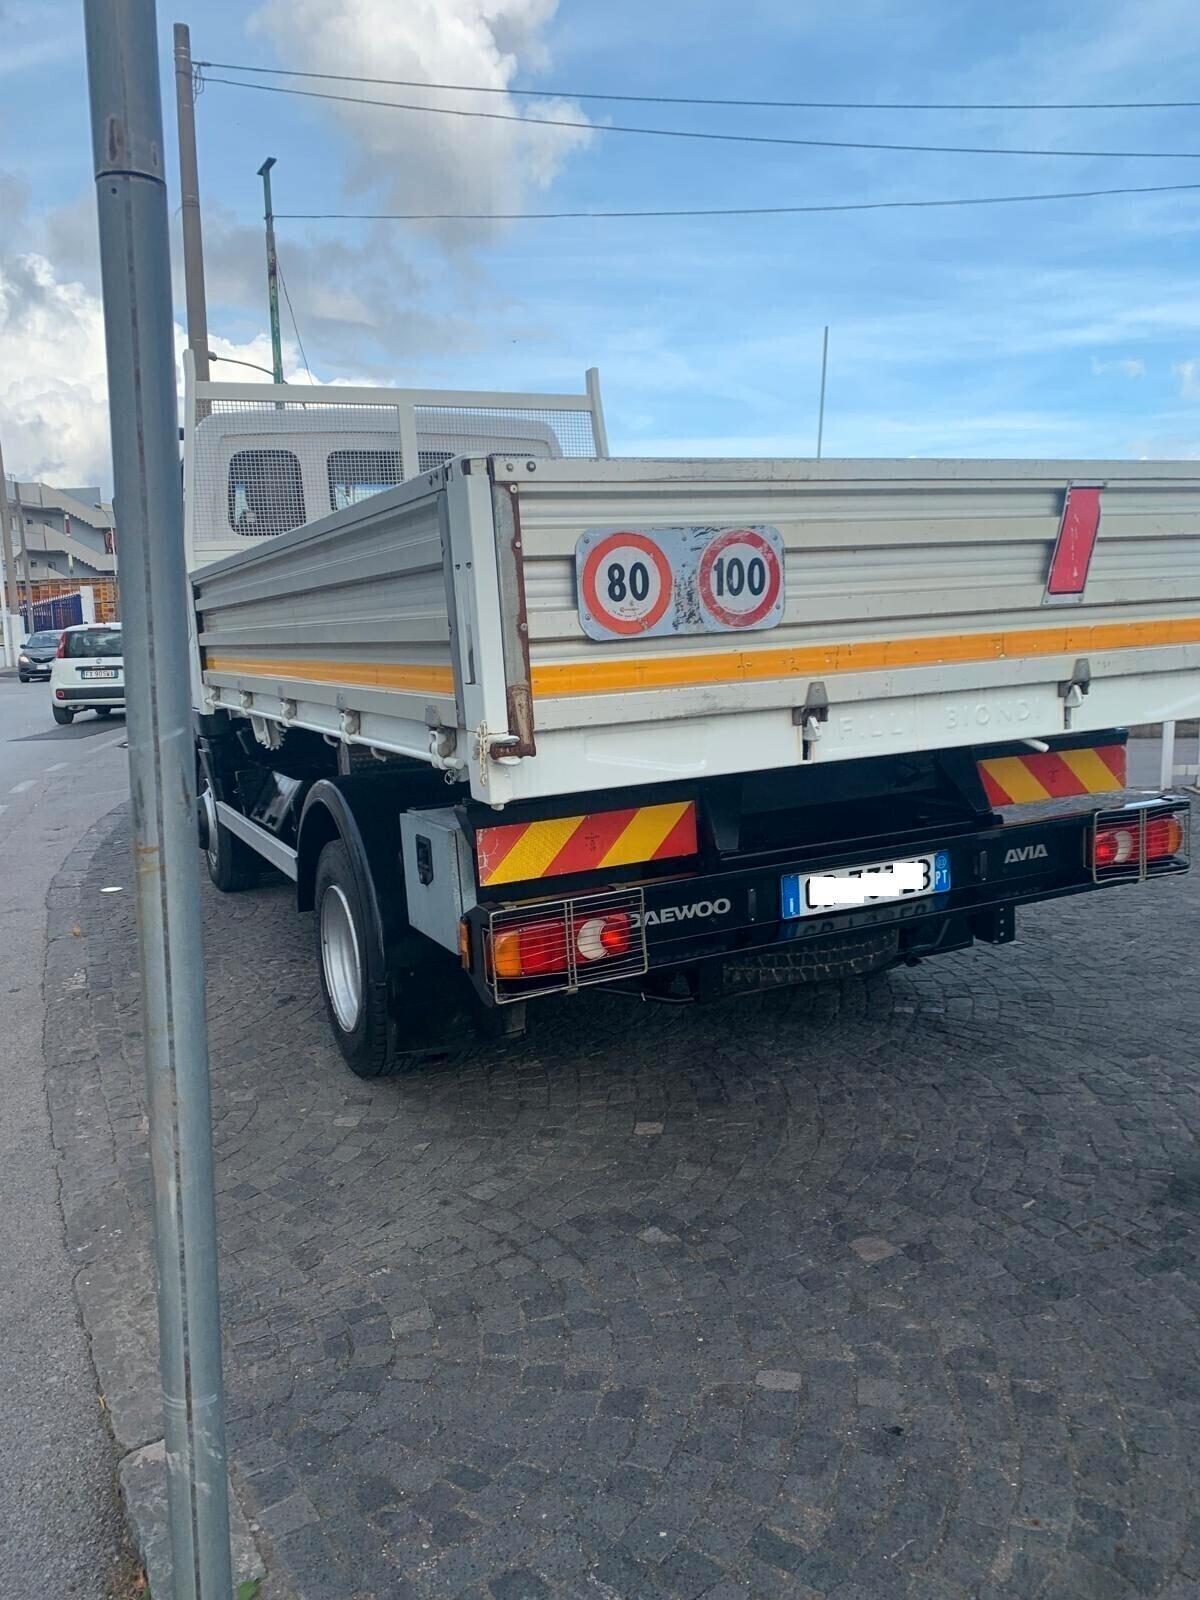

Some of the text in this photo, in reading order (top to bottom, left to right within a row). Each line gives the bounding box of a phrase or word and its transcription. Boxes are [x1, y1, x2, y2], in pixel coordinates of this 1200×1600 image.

[607, 562, 649, 602] 80
[713, 557, 766, 597] 100
[1004, 844, 1049, 864] AVIA
[935, 869, 948, 885] PT
[630, 898, 732, 928] DAEWOO
